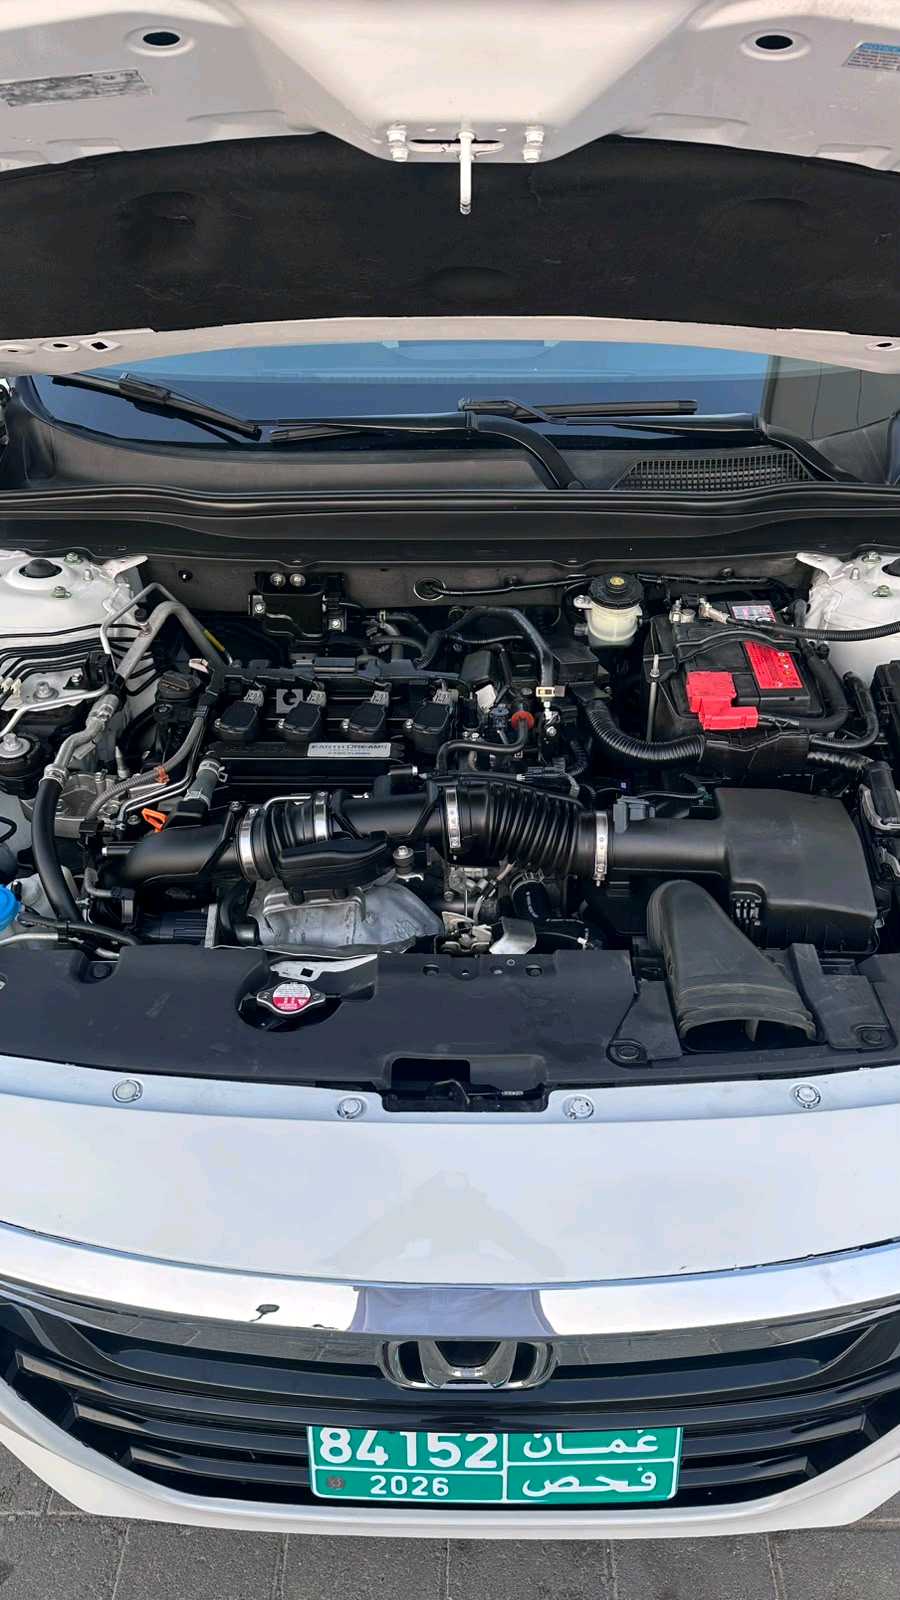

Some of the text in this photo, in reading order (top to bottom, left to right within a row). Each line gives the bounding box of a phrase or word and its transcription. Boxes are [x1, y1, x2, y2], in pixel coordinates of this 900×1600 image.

[319, 1426, 498, 1469] 84152
[370, 1475, 449, 1497] 2026
[522, 1466, 657, 1497] فحص
